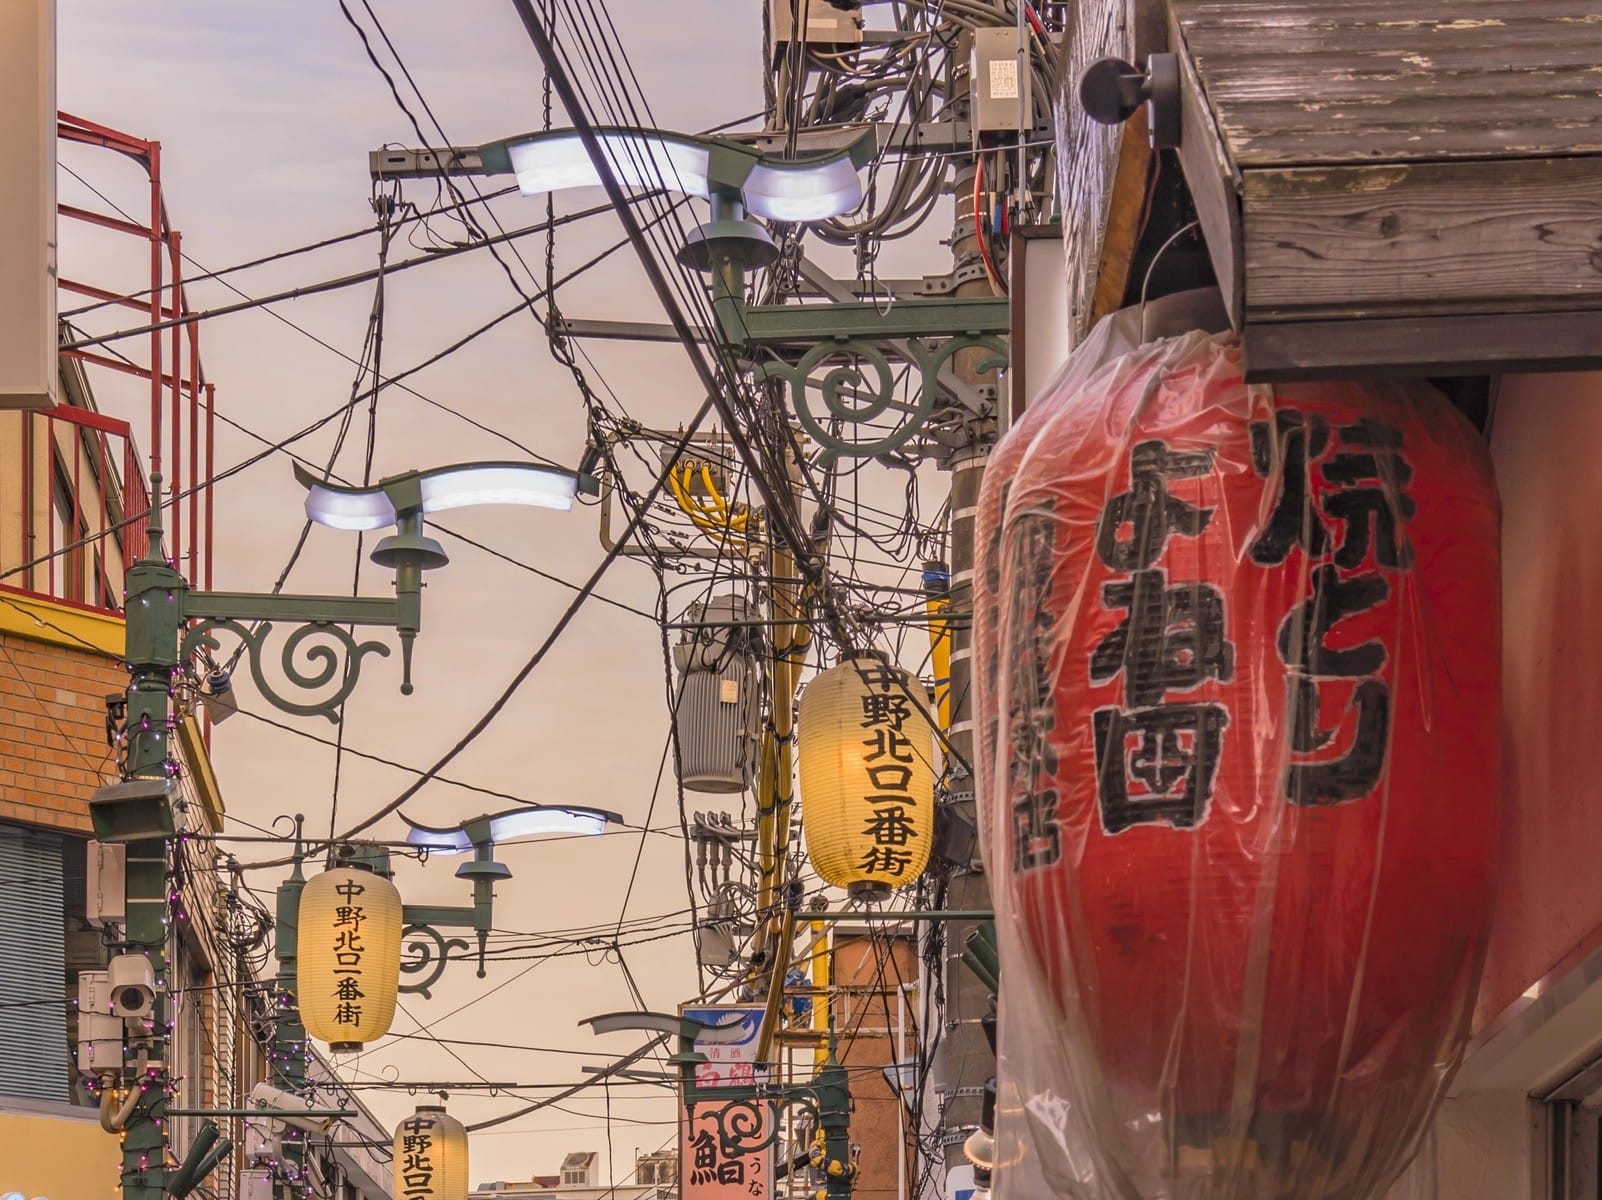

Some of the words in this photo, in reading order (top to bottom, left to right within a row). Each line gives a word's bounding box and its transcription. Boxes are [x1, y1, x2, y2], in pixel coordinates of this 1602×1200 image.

[855, 665, 918, 876] 中野北口一番街
[332, 879, 366, 1028] 中野北口一番街
[709, 1047, 741, 1060] 清酒
